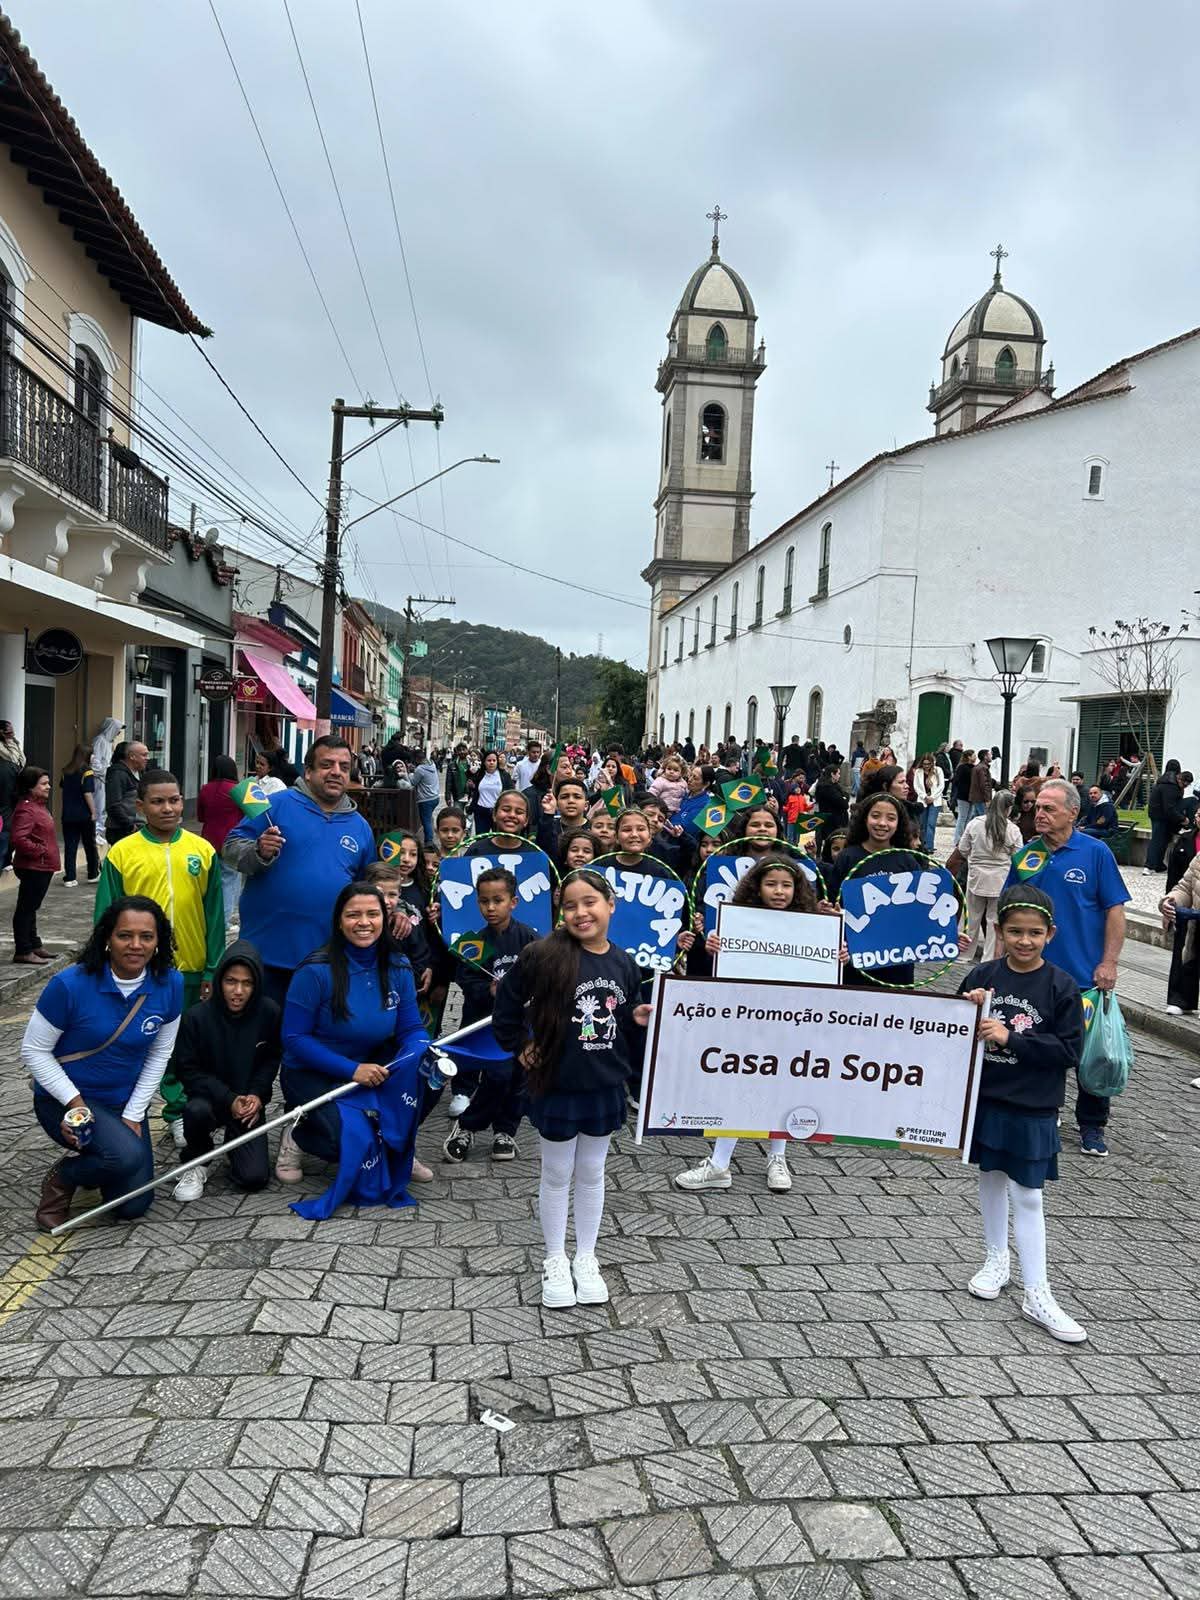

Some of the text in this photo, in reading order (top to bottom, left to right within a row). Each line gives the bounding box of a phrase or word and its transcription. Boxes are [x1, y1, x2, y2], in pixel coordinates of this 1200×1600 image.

[606, 867, 684, 947] LTURA
[844, 872, 959, 933] LAZER
[720, 937, 837, 960] RESPONSABILIDADE
[852, 935, 959, 969] EDUCAÇÃO
[673, 1002, 969, 1038] Ação e Promoção Social de Iguape
[700, 1047, 924, 1091] Casa da Sopa
[906, 1127, 947, 1138] PREFEITURA
[919, 1136, 944, 1144] IGUAPE
